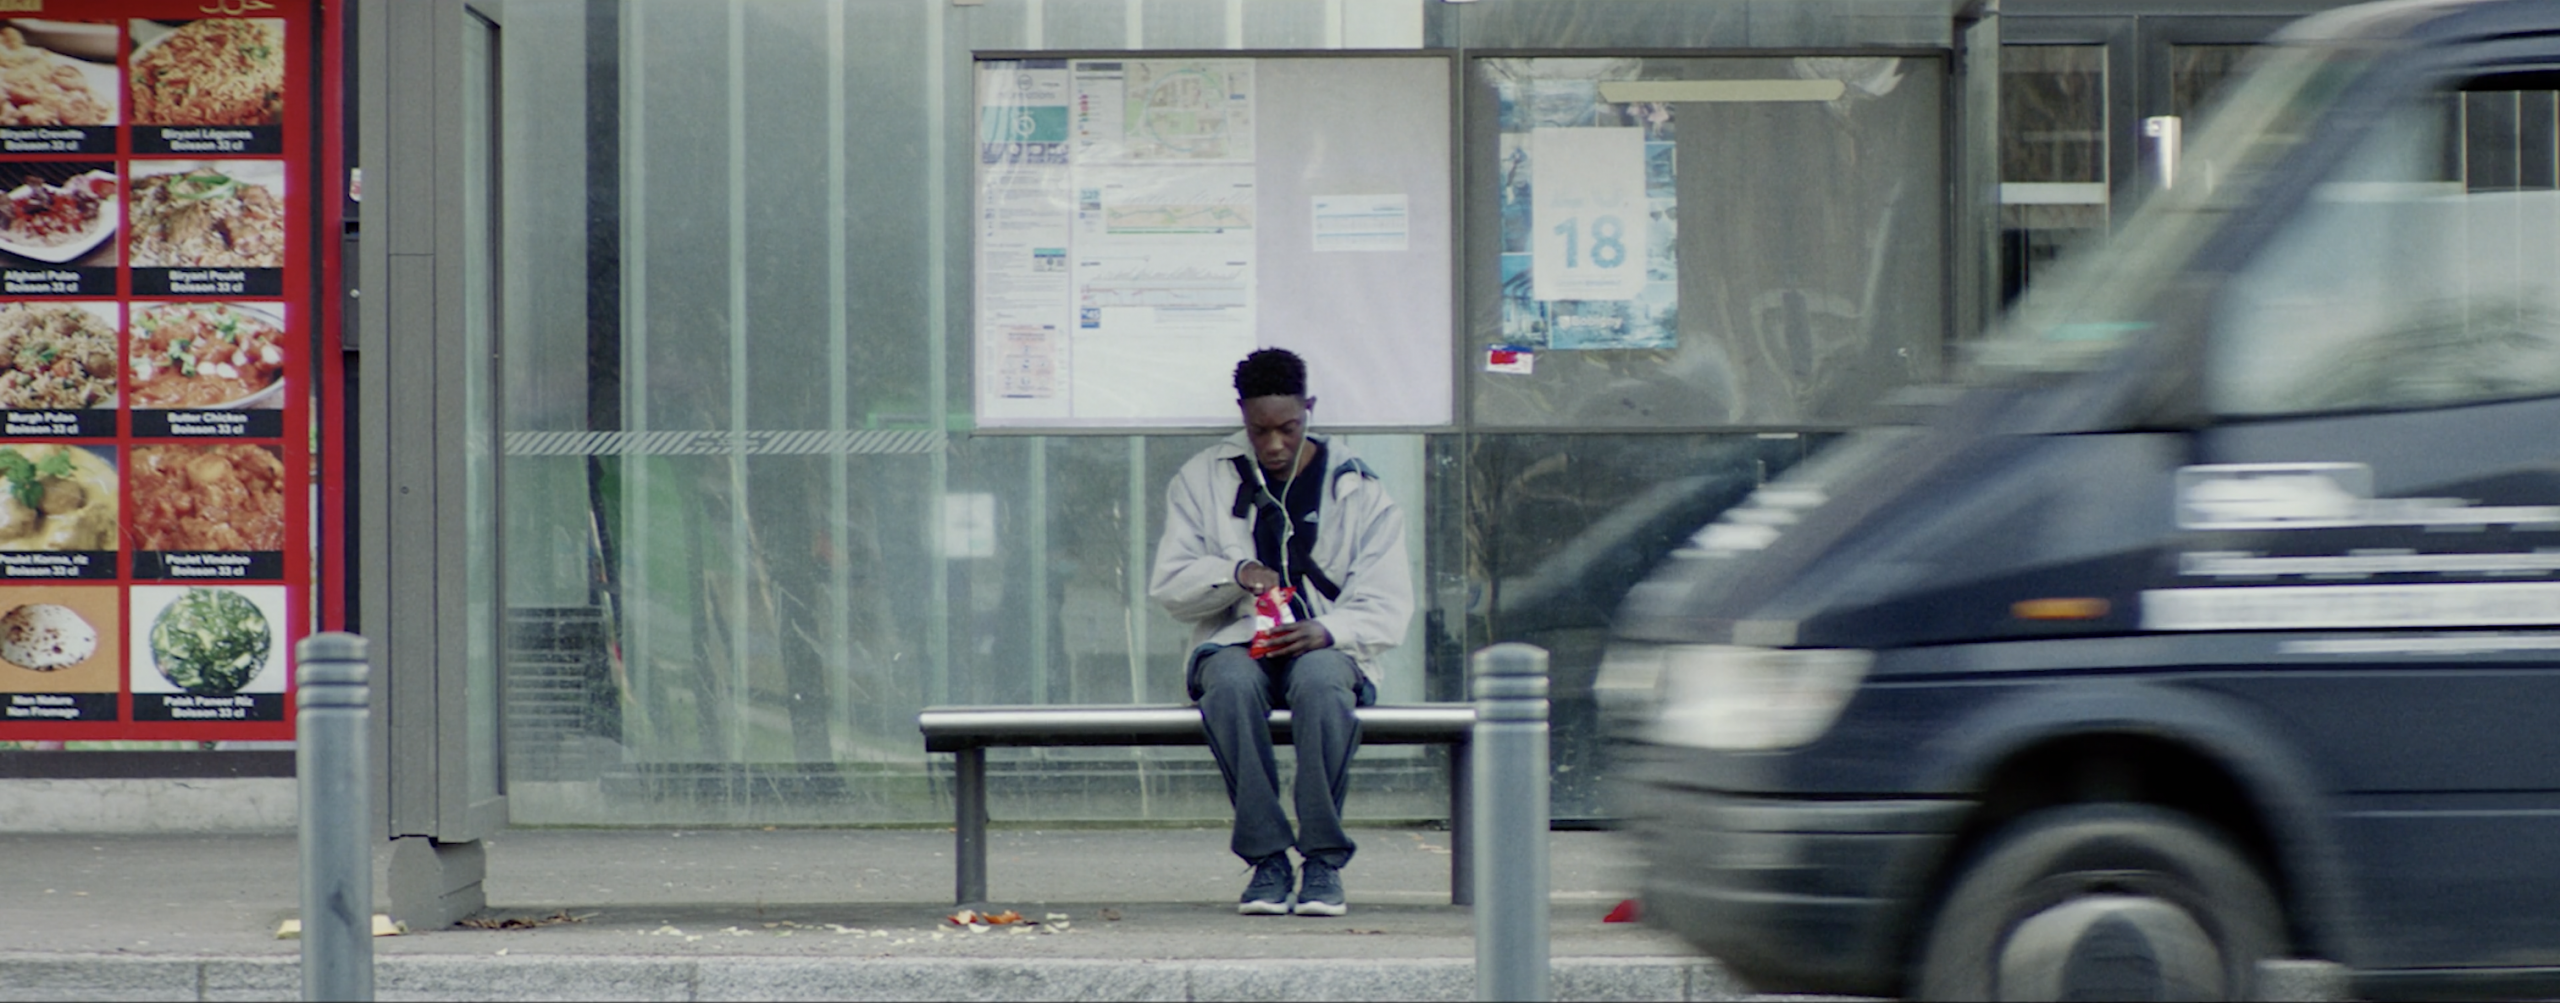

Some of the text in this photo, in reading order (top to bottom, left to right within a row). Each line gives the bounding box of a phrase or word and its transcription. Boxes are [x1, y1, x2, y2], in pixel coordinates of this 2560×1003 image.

[0, 128, 85, 141] Biryani Crevette
[161, 128, 253, 141] Biryani Légumes
[4, 140, 78, 151] Boisson 33 cl
[170, 140, 245, 151] Boisson 33 cl
[1553, 214, 1627, 269] 18
[4, 270, 80, 283] Afghani Pulao
[169, 270, 245, 283] Biryani Poulet
[4, 281, 78, 293] Boisson 33 cl
[170, 281, 245, 293] Boisson 33 cl
[7, 412, 77, 424] Murgh Pulao
[167, 412, 249, 423] Butter Chicken
[5, 423, 79, 435] Boisson 33 cl
[171, 423, 245, 435] Boisson 33 cl
[73, 554, 89, 565] riz
[165, 554, 251, 565] Poulet Vindaloo
[5, 565, 79, 577] Boisson 33 cl
[171, 565, 245, 577] Boisson 33 cl
[36, 694, 75, 706] Nature
[163, 695, 194, 707] Palak
[195, 695, 234, 707] Paneer
[31, 706, 80, 719] Fromage
[171, 707, 246, 718] Boisson 33 cl
